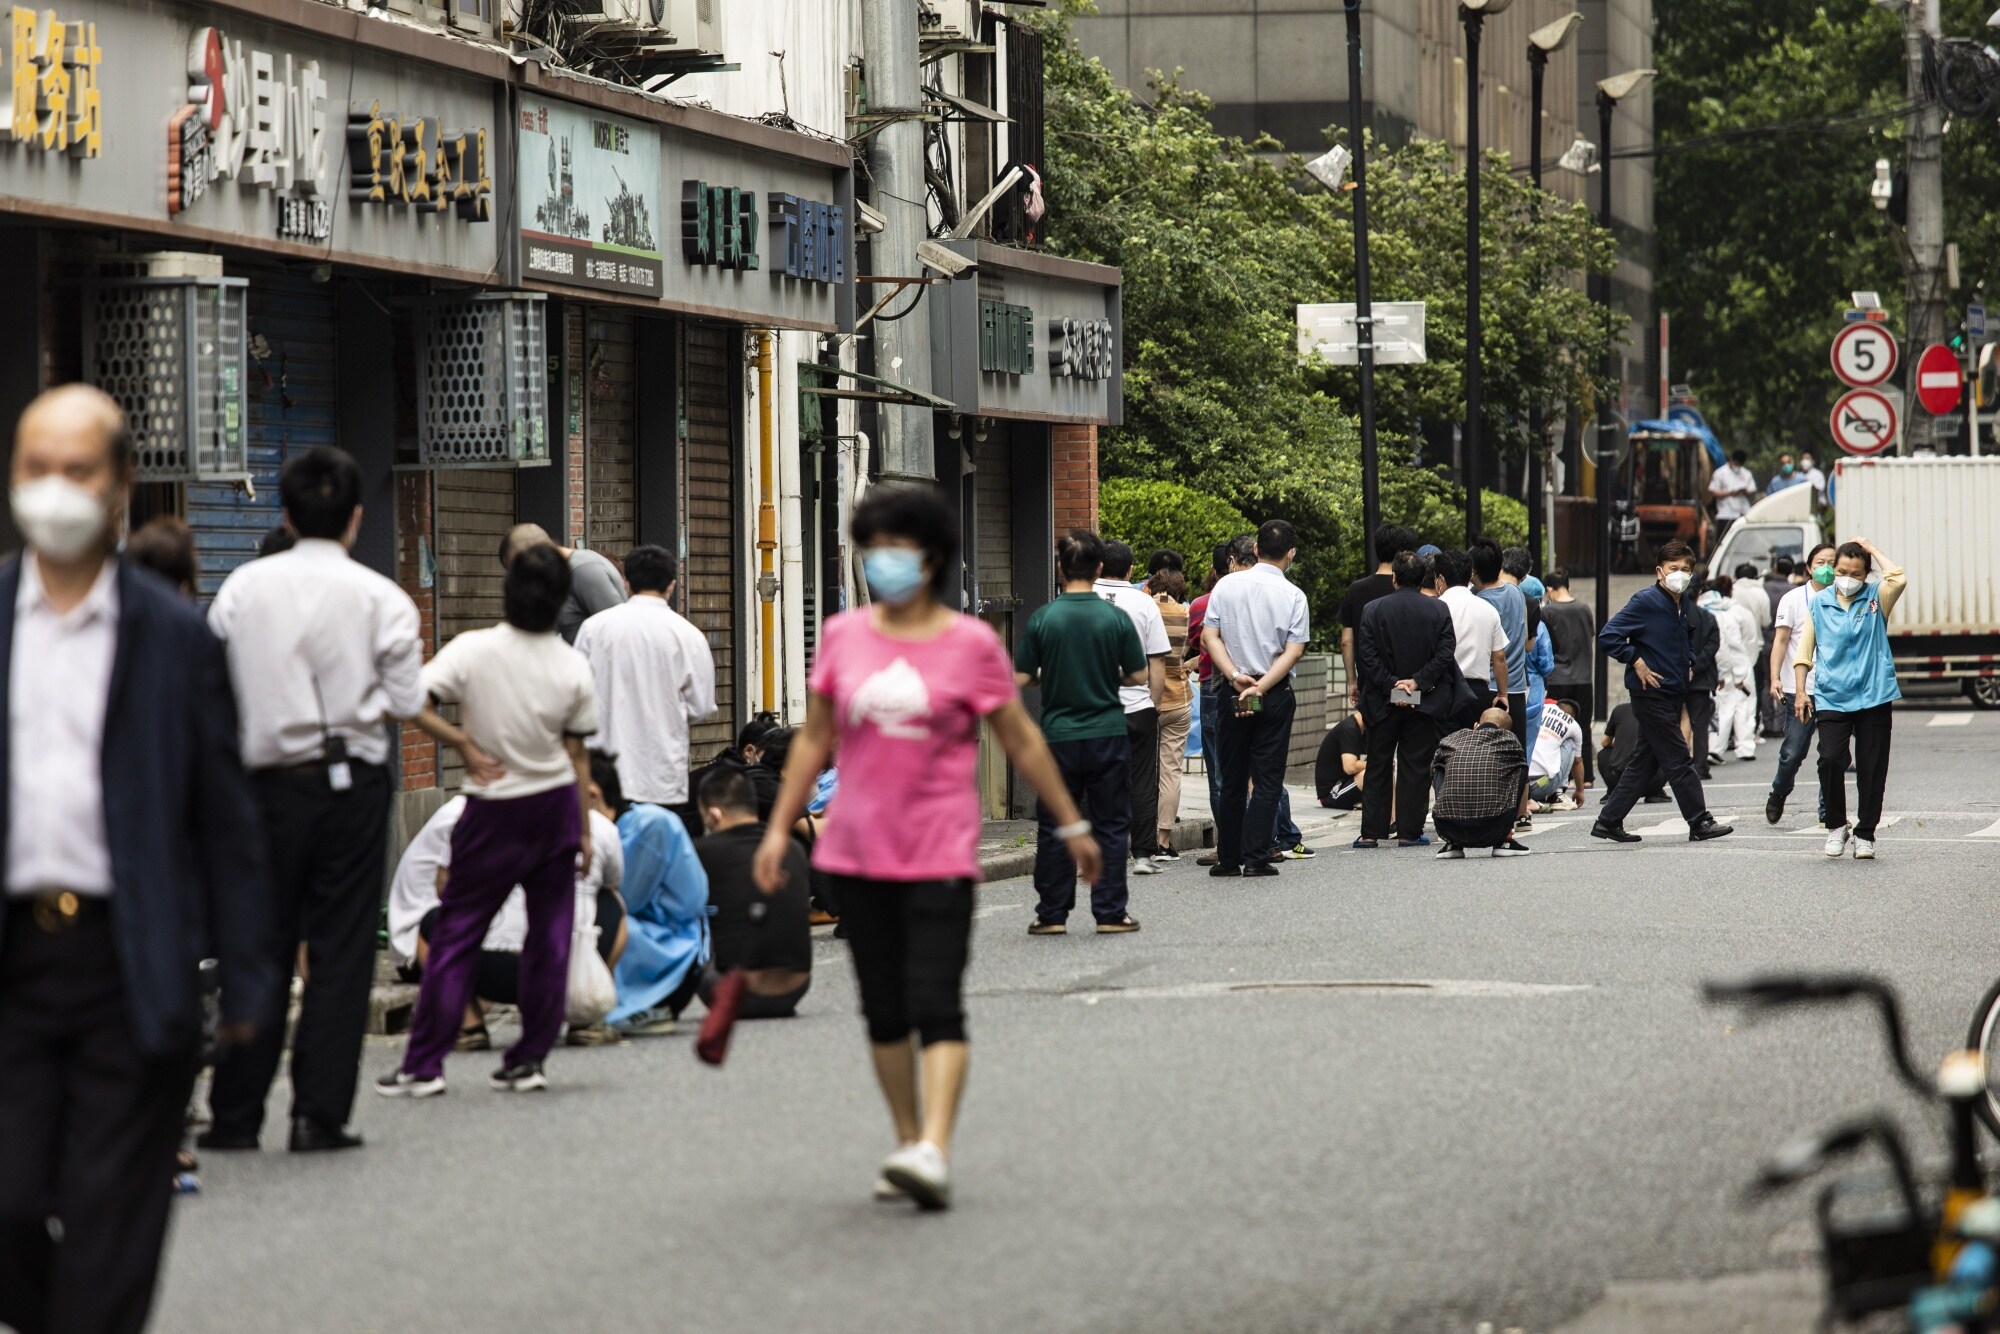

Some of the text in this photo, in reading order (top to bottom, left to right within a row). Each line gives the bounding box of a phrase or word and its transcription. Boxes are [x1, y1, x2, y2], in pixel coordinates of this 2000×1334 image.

[213, 30, 327, 195] 沙县小吃
[1854, 339, 1876, 371] 5
